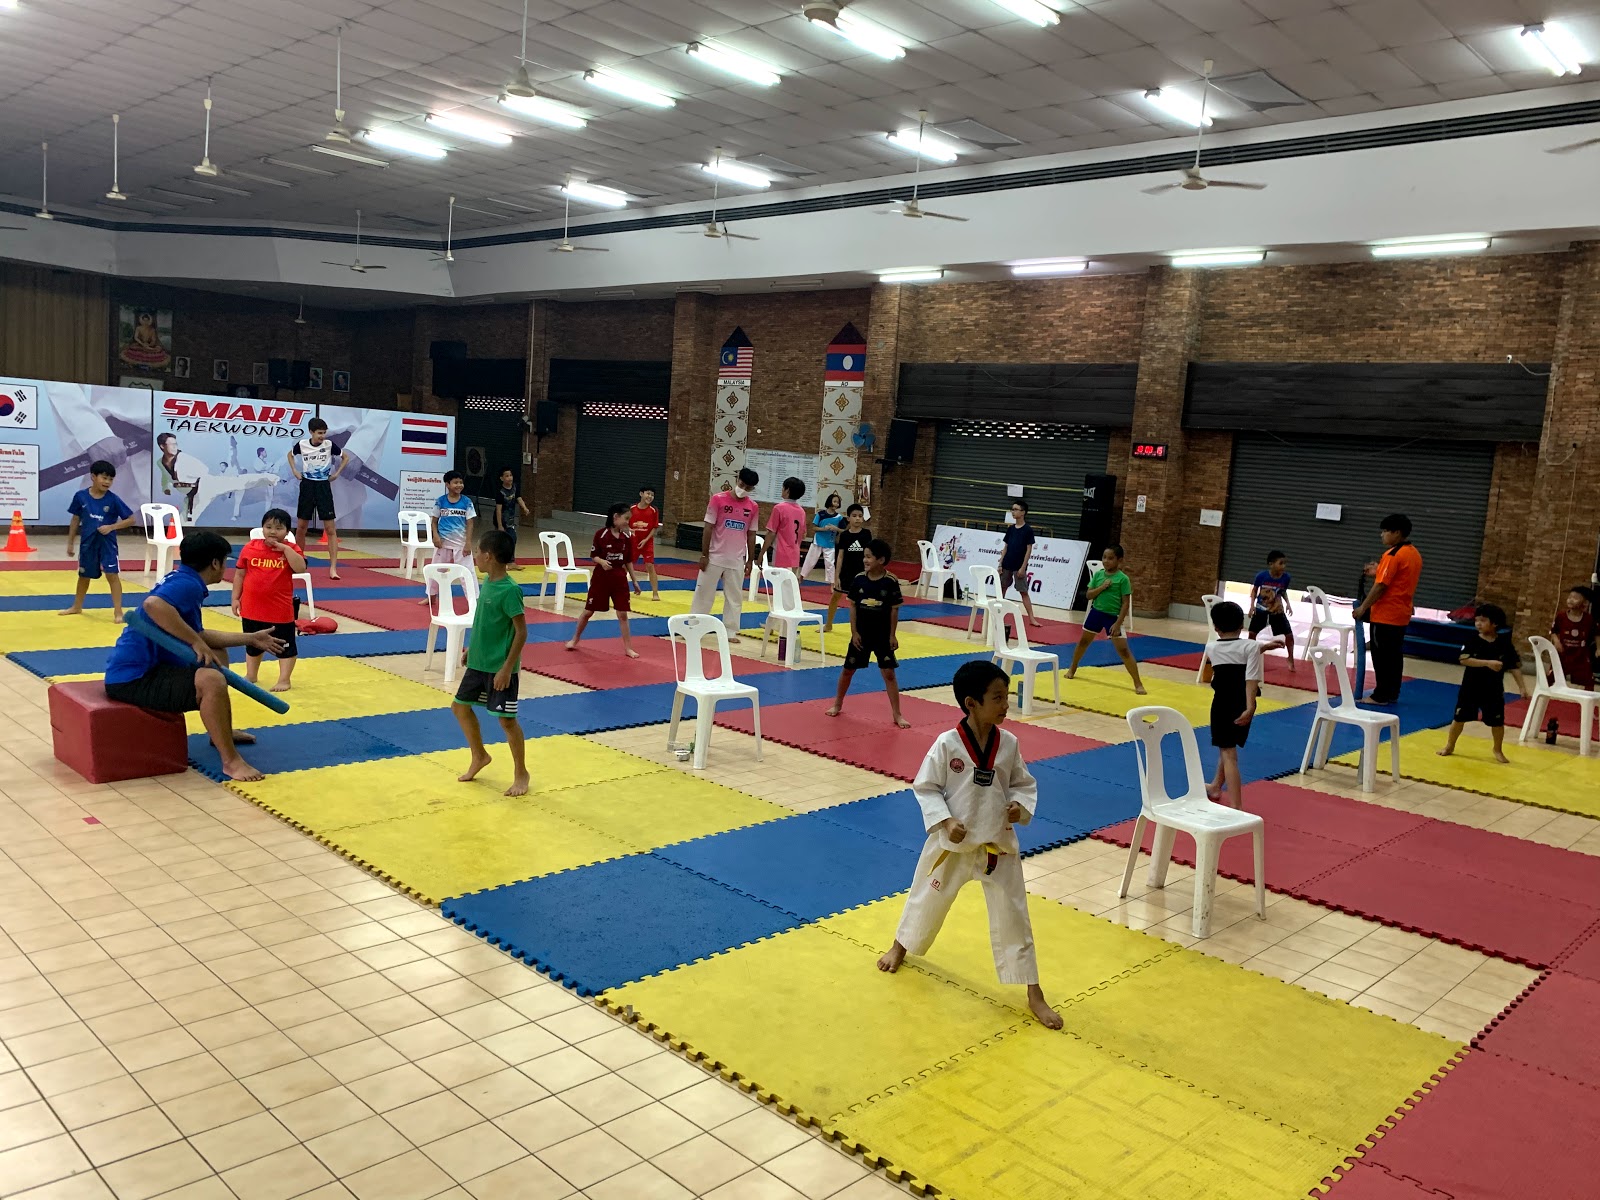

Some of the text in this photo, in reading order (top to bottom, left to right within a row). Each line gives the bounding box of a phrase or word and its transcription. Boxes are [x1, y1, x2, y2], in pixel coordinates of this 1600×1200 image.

[161, 398, 311, 425] SMART
[166, 419, 305, 438] TAEKWONDO
[723, 505, 734, 514] 99
[250, 557, 285, 569] CHINA
